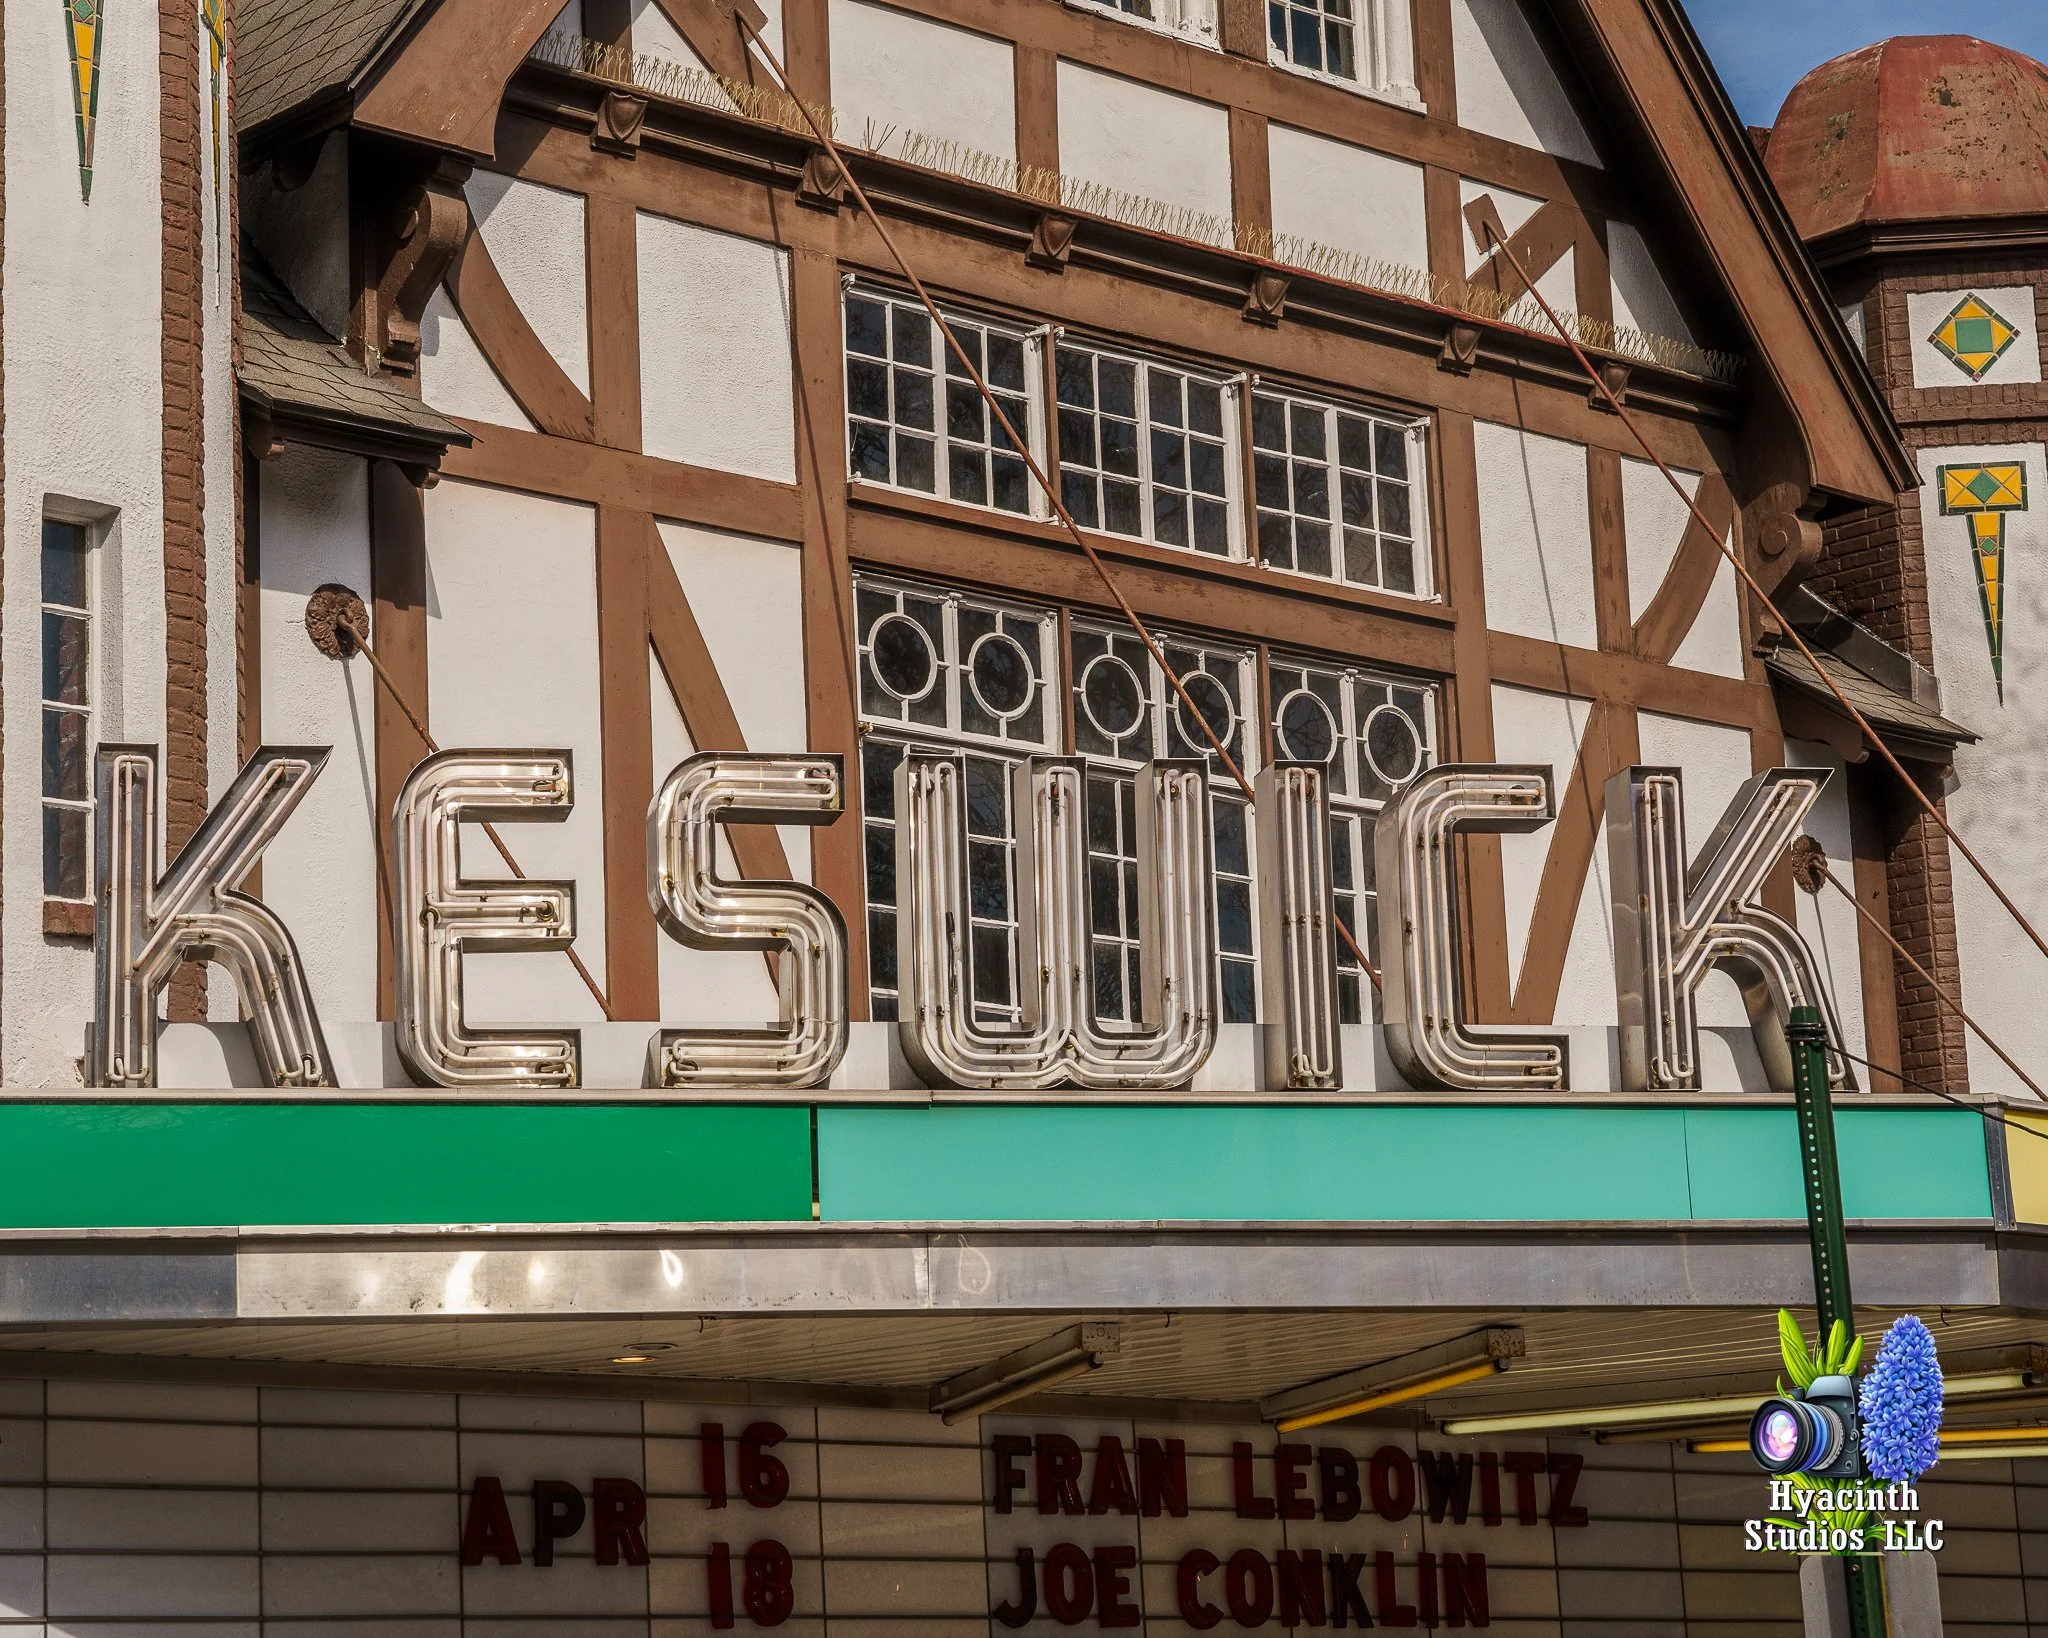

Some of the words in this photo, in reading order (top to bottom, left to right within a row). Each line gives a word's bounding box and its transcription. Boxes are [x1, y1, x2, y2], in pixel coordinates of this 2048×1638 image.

[95, 743, 1861, 1091] KESWICK
[460, 1476, 650, 1567] APR
[701, 1421, 790, 1509] 16
[993, 1433, 1189, 1518] FRAN
[1232, 1441, 1590, 1528] LEBOWITZ
[706, 1539, 795, 1629] 18
[992, 1542, 1141, 1629] JOE
[1176, 1548, 1491, 1630] CONKLIN
